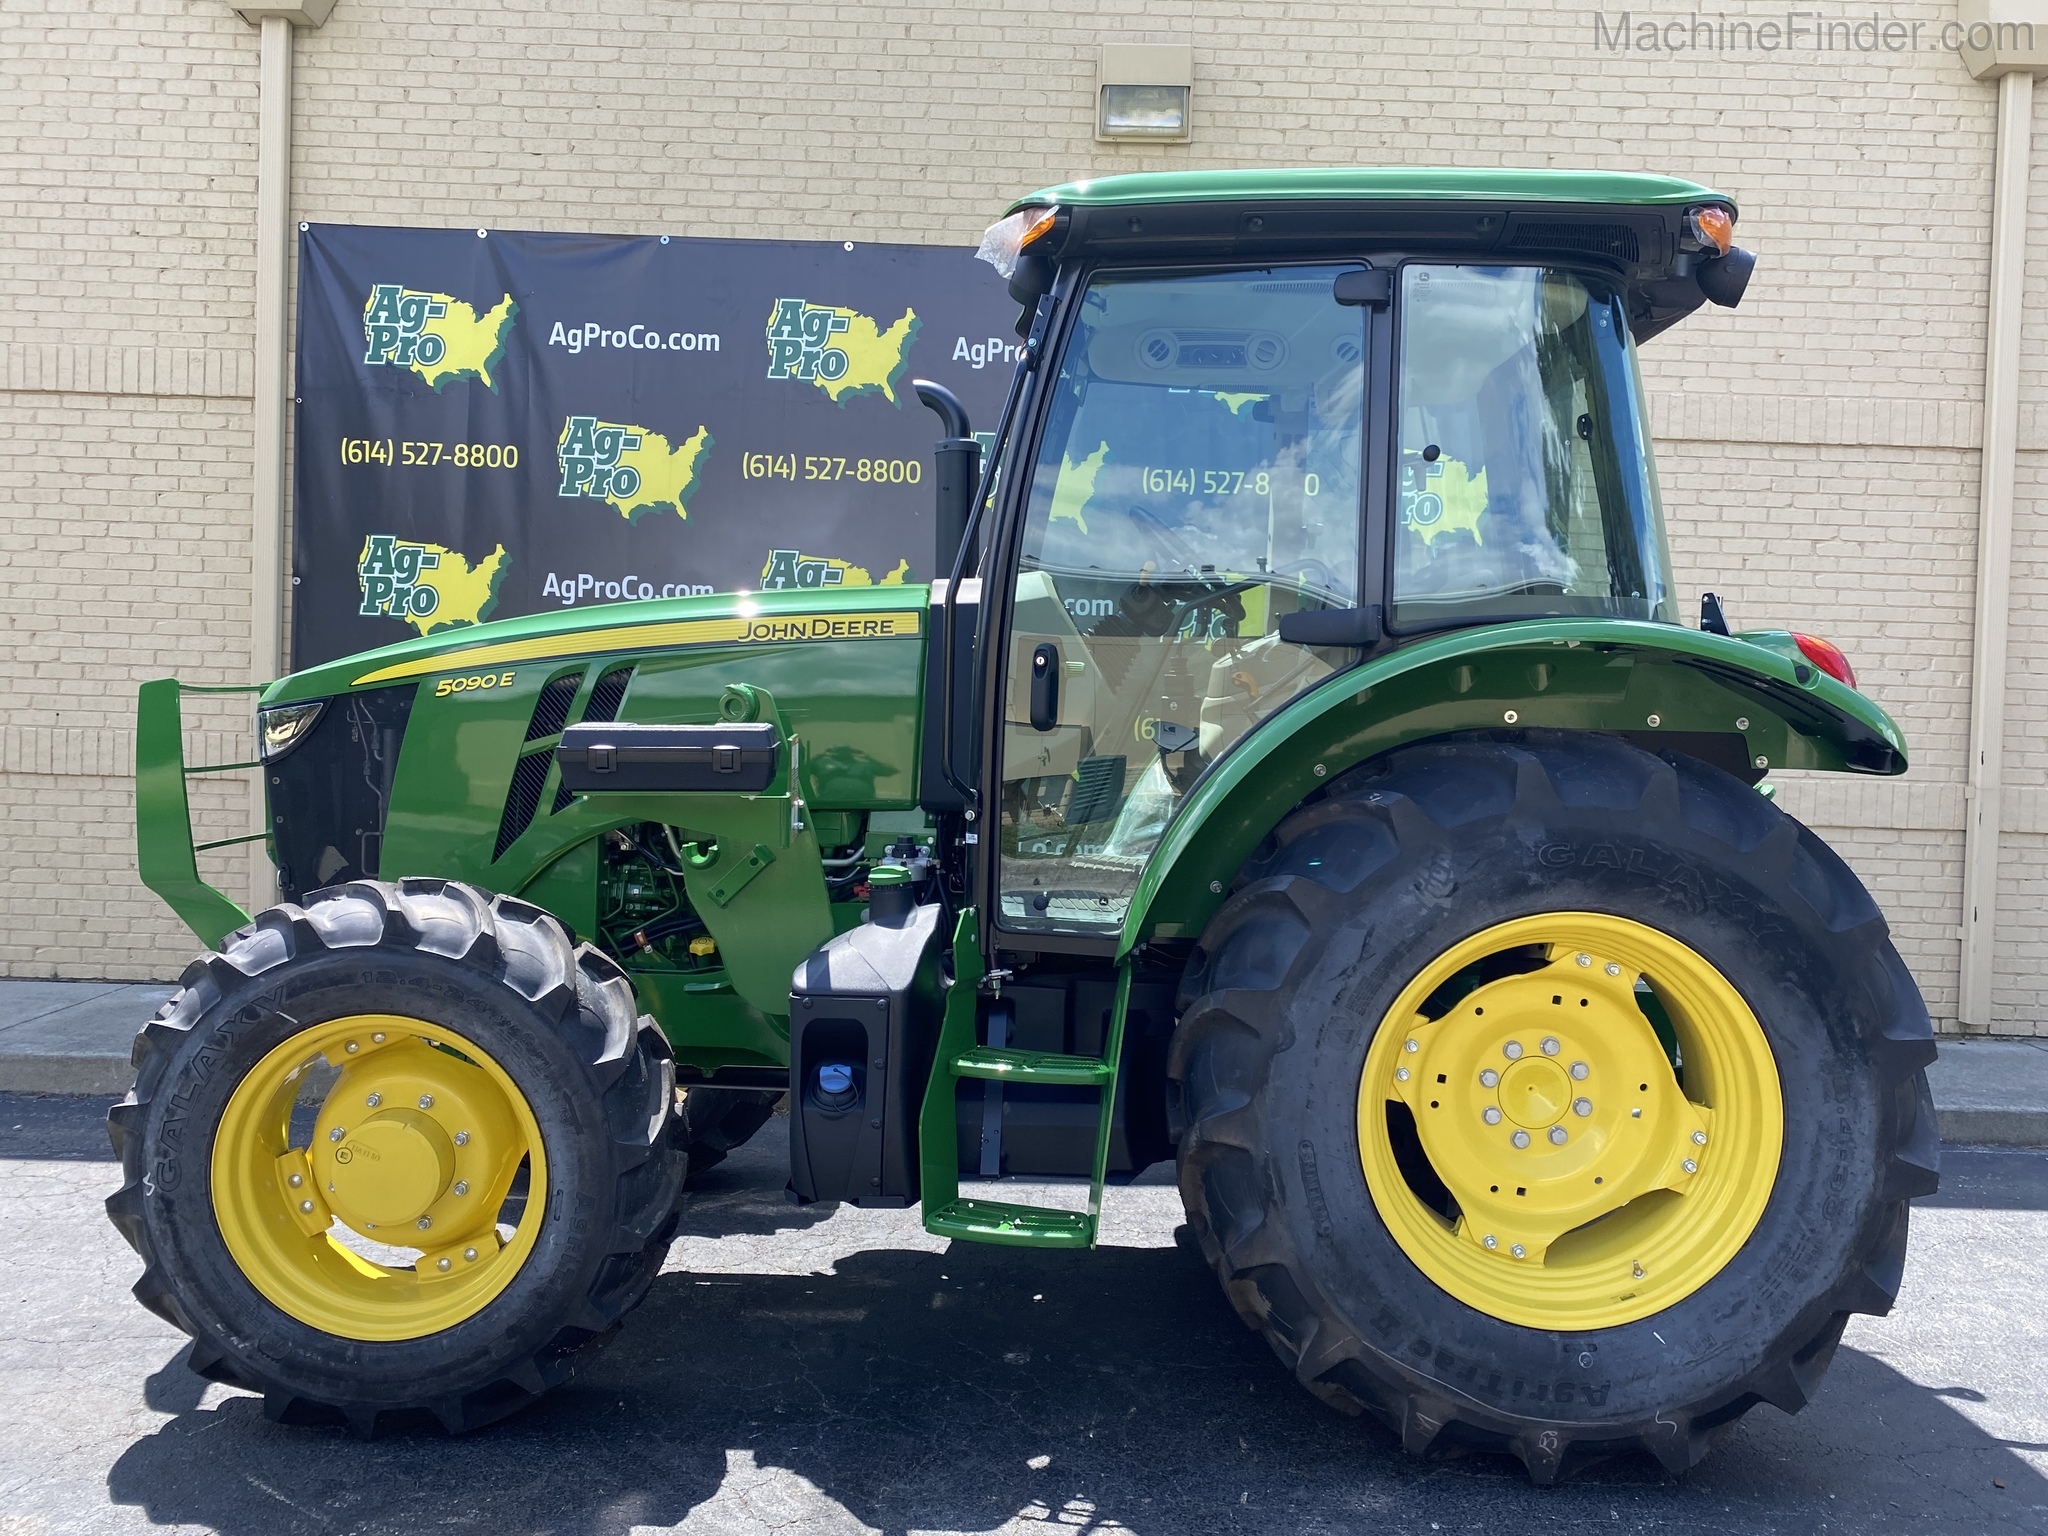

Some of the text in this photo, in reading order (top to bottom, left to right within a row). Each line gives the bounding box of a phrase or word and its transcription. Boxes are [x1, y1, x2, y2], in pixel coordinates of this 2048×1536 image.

[367, 284, 447, 333] Ag-
[771, 298, 851, 349] Ag-
[364, 324, 447, 365] Pro
[548, 321, 721, 354] AgProCo.com
[767, 338, 848, 380] Pro
[341, 437, 519, 469] (614) 527-8800
[560, 416, 642, 466] Ag-
[558, 456, 641, 498] Pro
[742, 451, 922, 484] (614) 527-8800
[1142, 466, 1320, 497] (614) 527-80
[359, 535, 440, 585] Ag-
[358, 575, 439, 617] Pro
[542, 572, 714, 605] AgProCo.com
[737, 618, 894, 642] JOHN DEERE
[1537, 841, 1784, 939] GALAXY
[155, 984, 286, 1193] GALAXY
